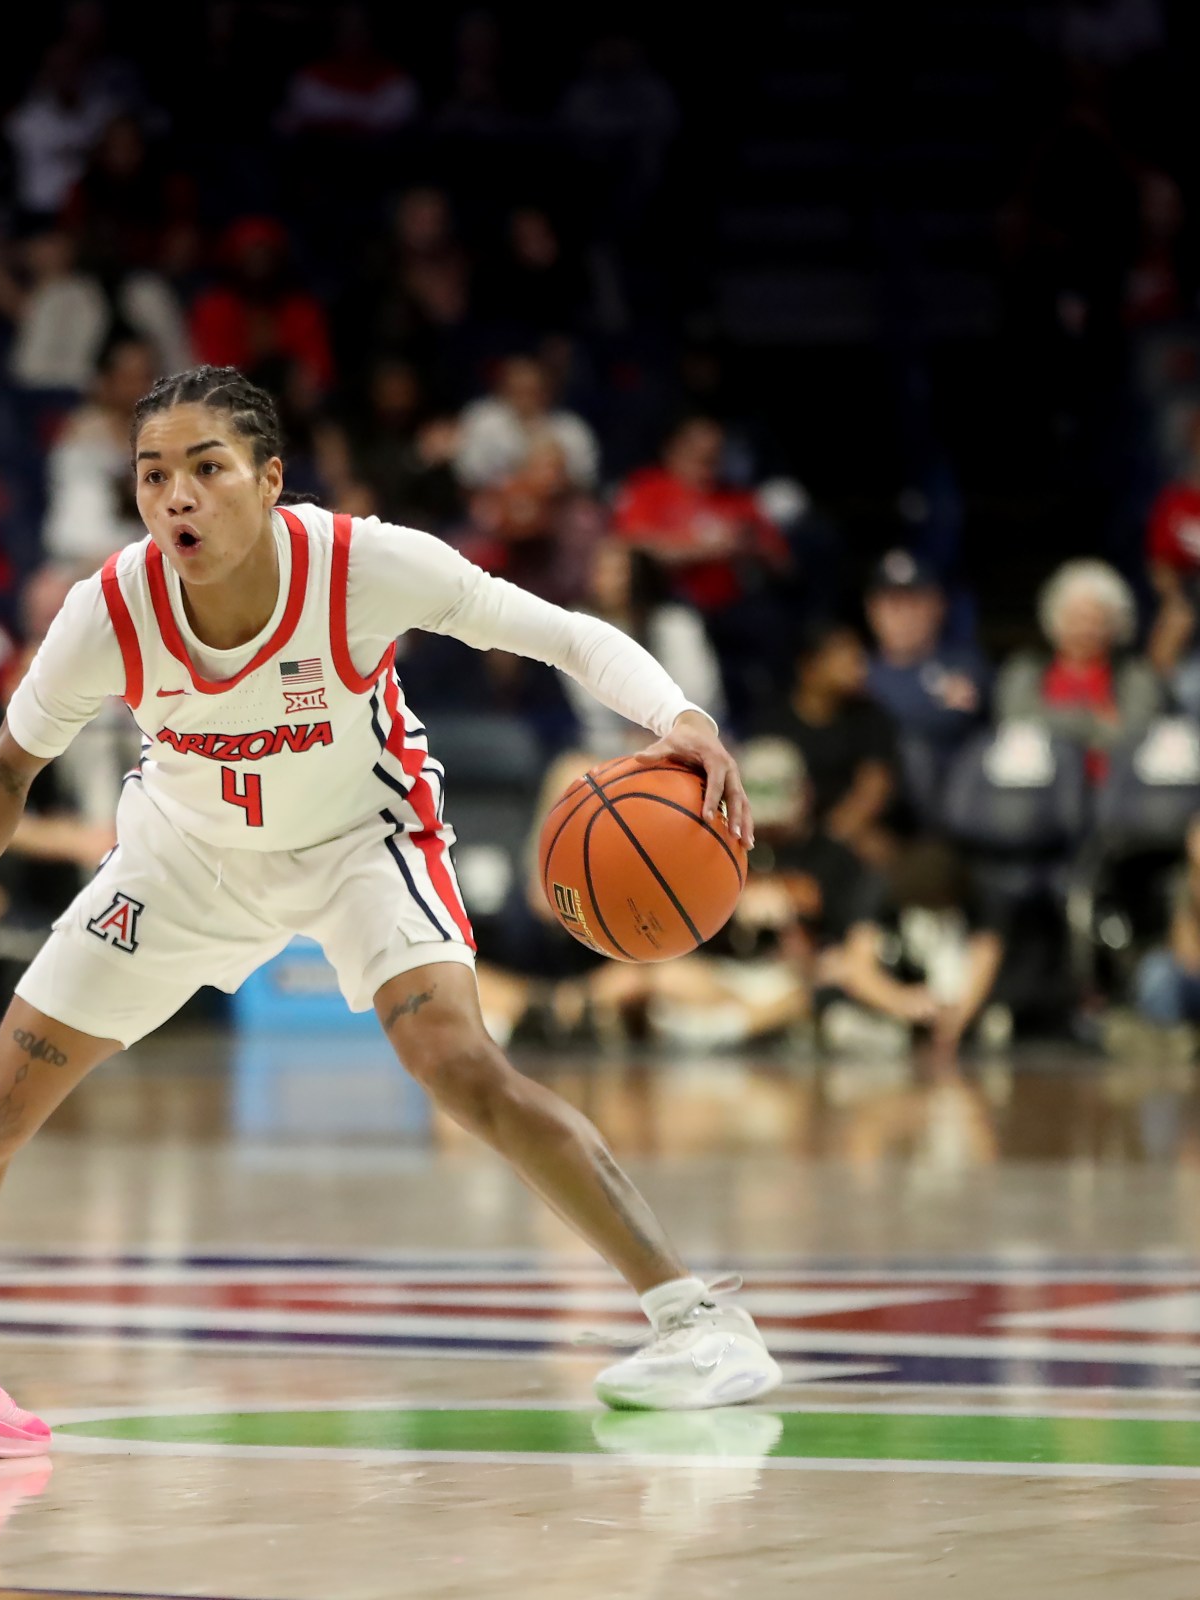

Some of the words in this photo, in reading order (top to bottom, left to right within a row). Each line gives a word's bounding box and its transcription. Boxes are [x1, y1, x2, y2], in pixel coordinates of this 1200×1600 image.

[282, 687, 328, 714] XII
[156, 721, 334, 762] ARIZONA
[221, 765, 264, 828] 4
[86, 891, 145, 955] A
